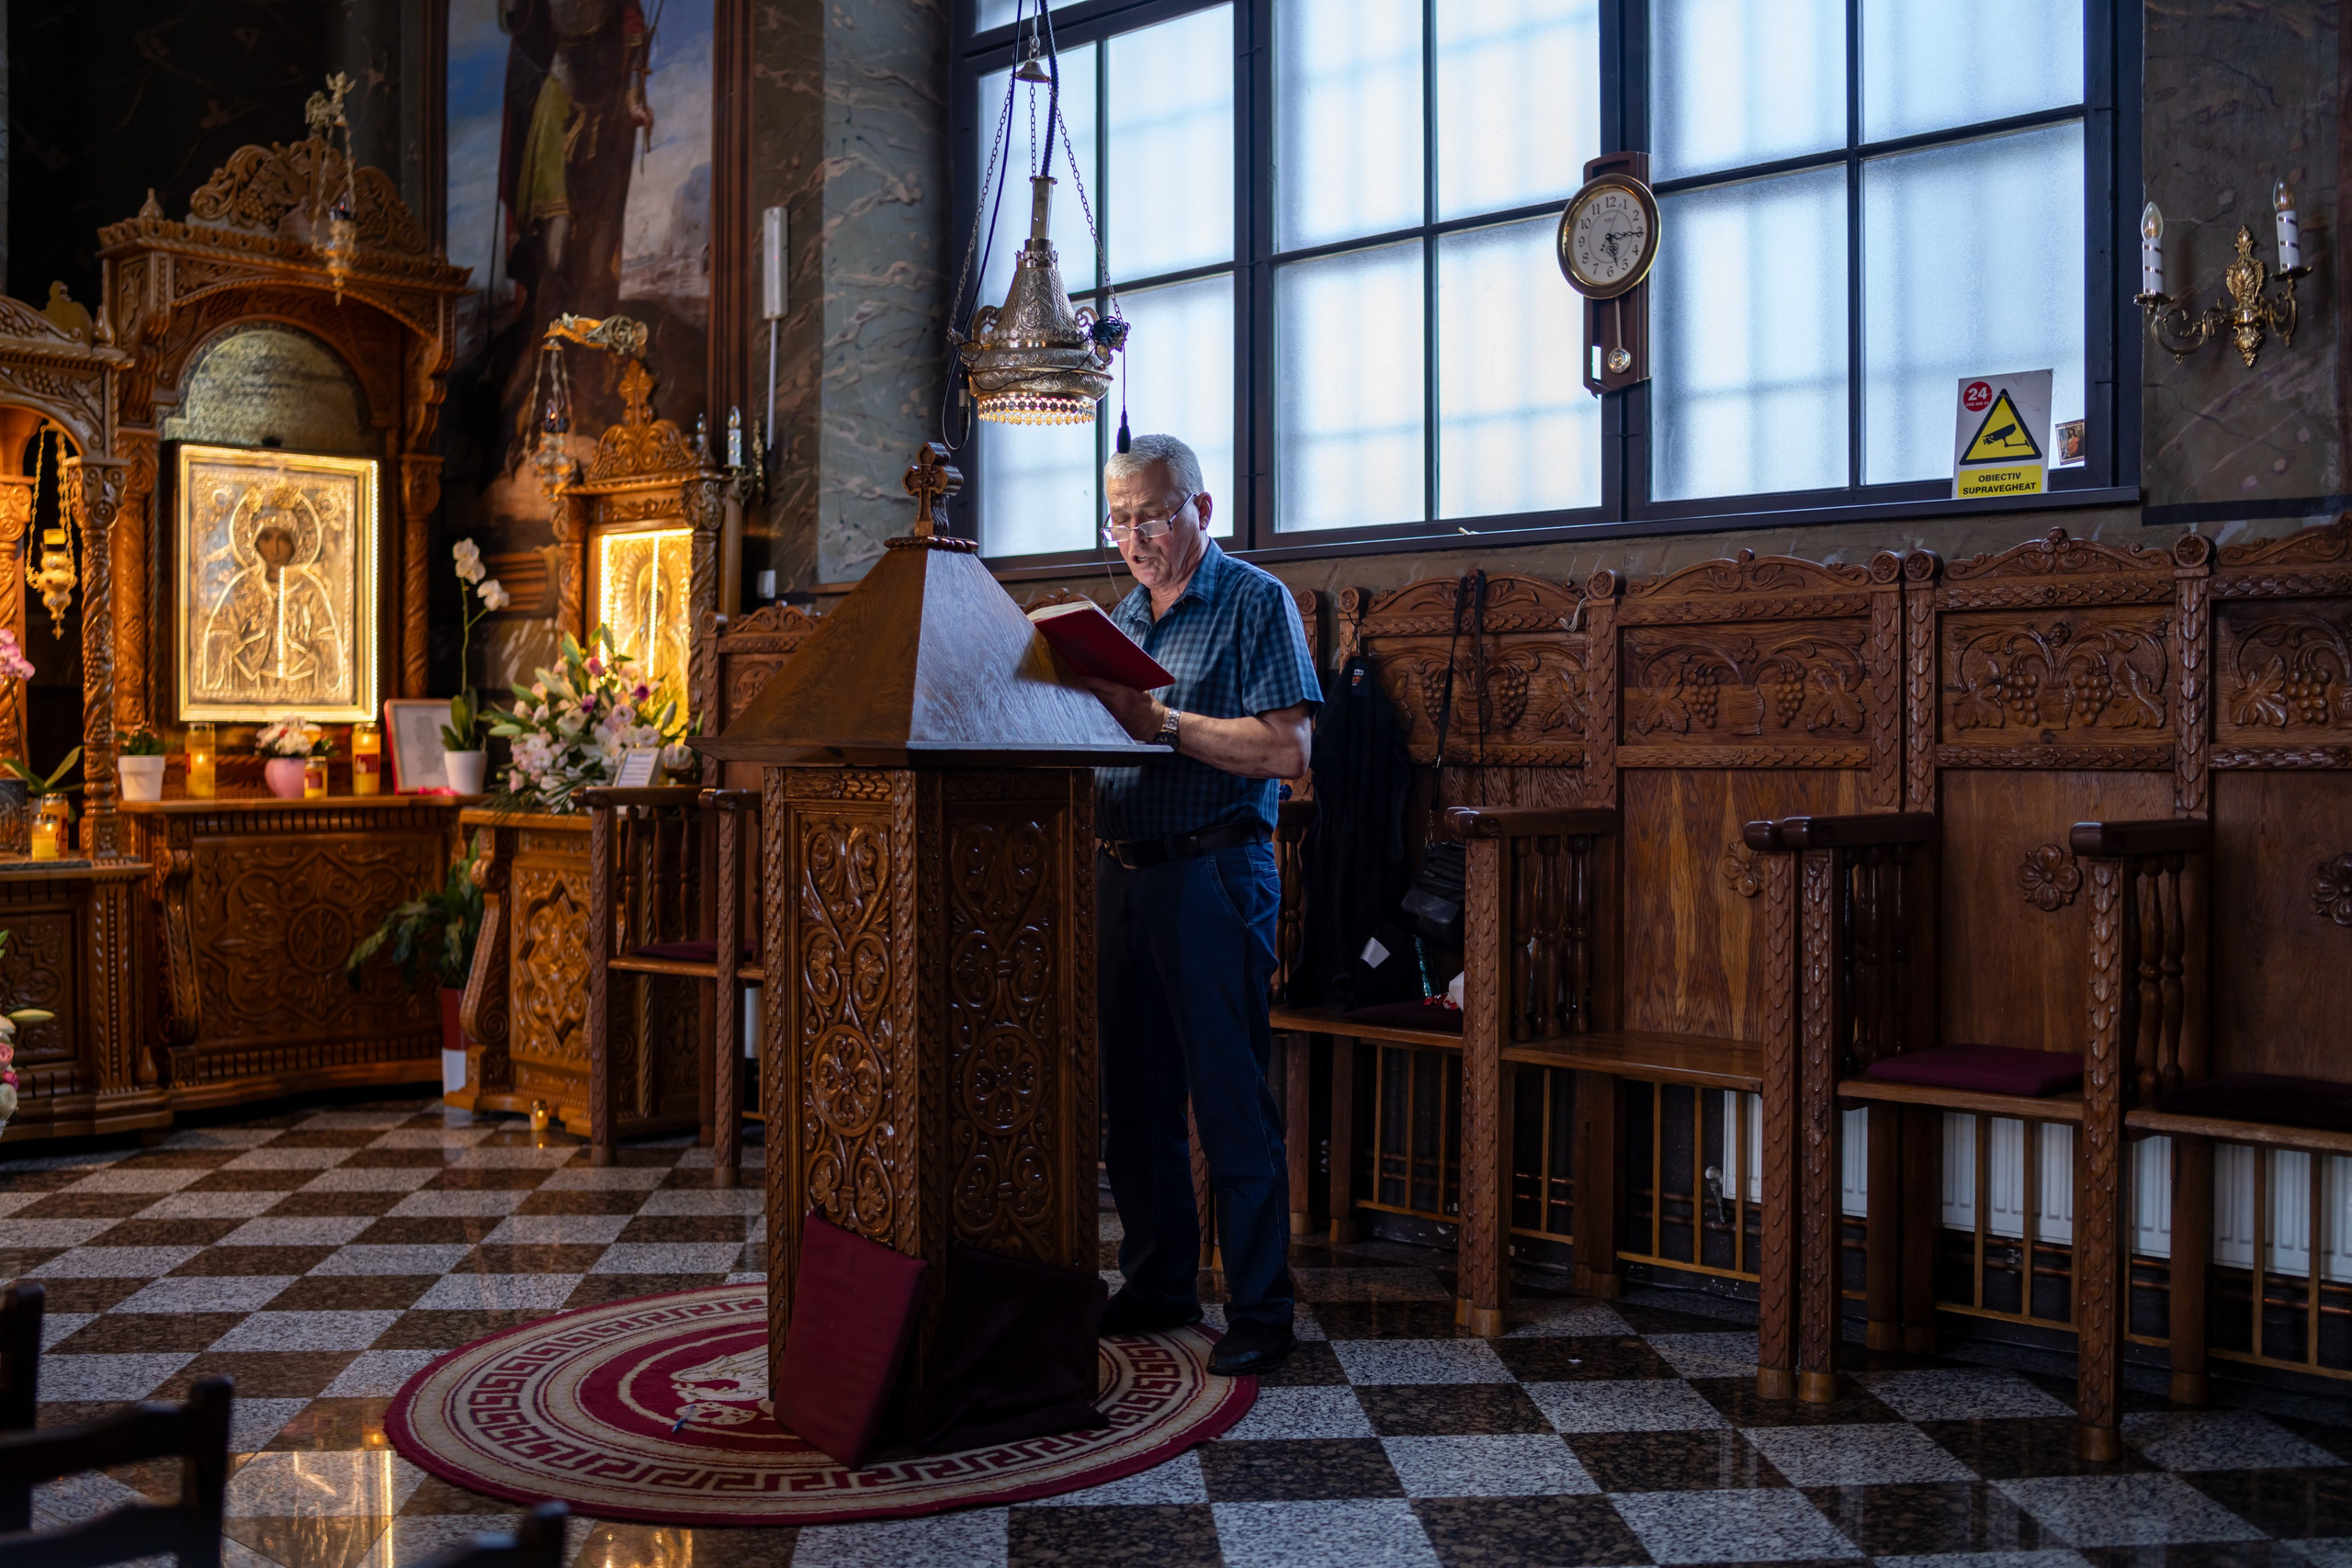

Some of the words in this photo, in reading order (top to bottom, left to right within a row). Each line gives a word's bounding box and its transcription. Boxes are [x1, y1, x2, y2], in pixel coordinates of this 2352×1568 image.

[1605, 196, 1617, 209] 12
[1592, 203, 1600, 216] 11
[1633, 209, 1639, 221] 2
[1580, 218, 1591, 230] 10
[1636, 226, 1644, 239] 3
[1578, 235, 1585, 248] 9
[1632, 244, 1639, 256] 4
[1582, 252, 1589, 265] 8
[1621, 258, 1629, 271] 5
[1592, 263, 1600, 275] 7
[1607, 265, 1614, 277] 6
[1967, 387, 1988, 401] 24
[1978, 472, 2021, 483] OBIECTIV
[1962, 482, 2037, 495] SUPRAVEGHEAT
